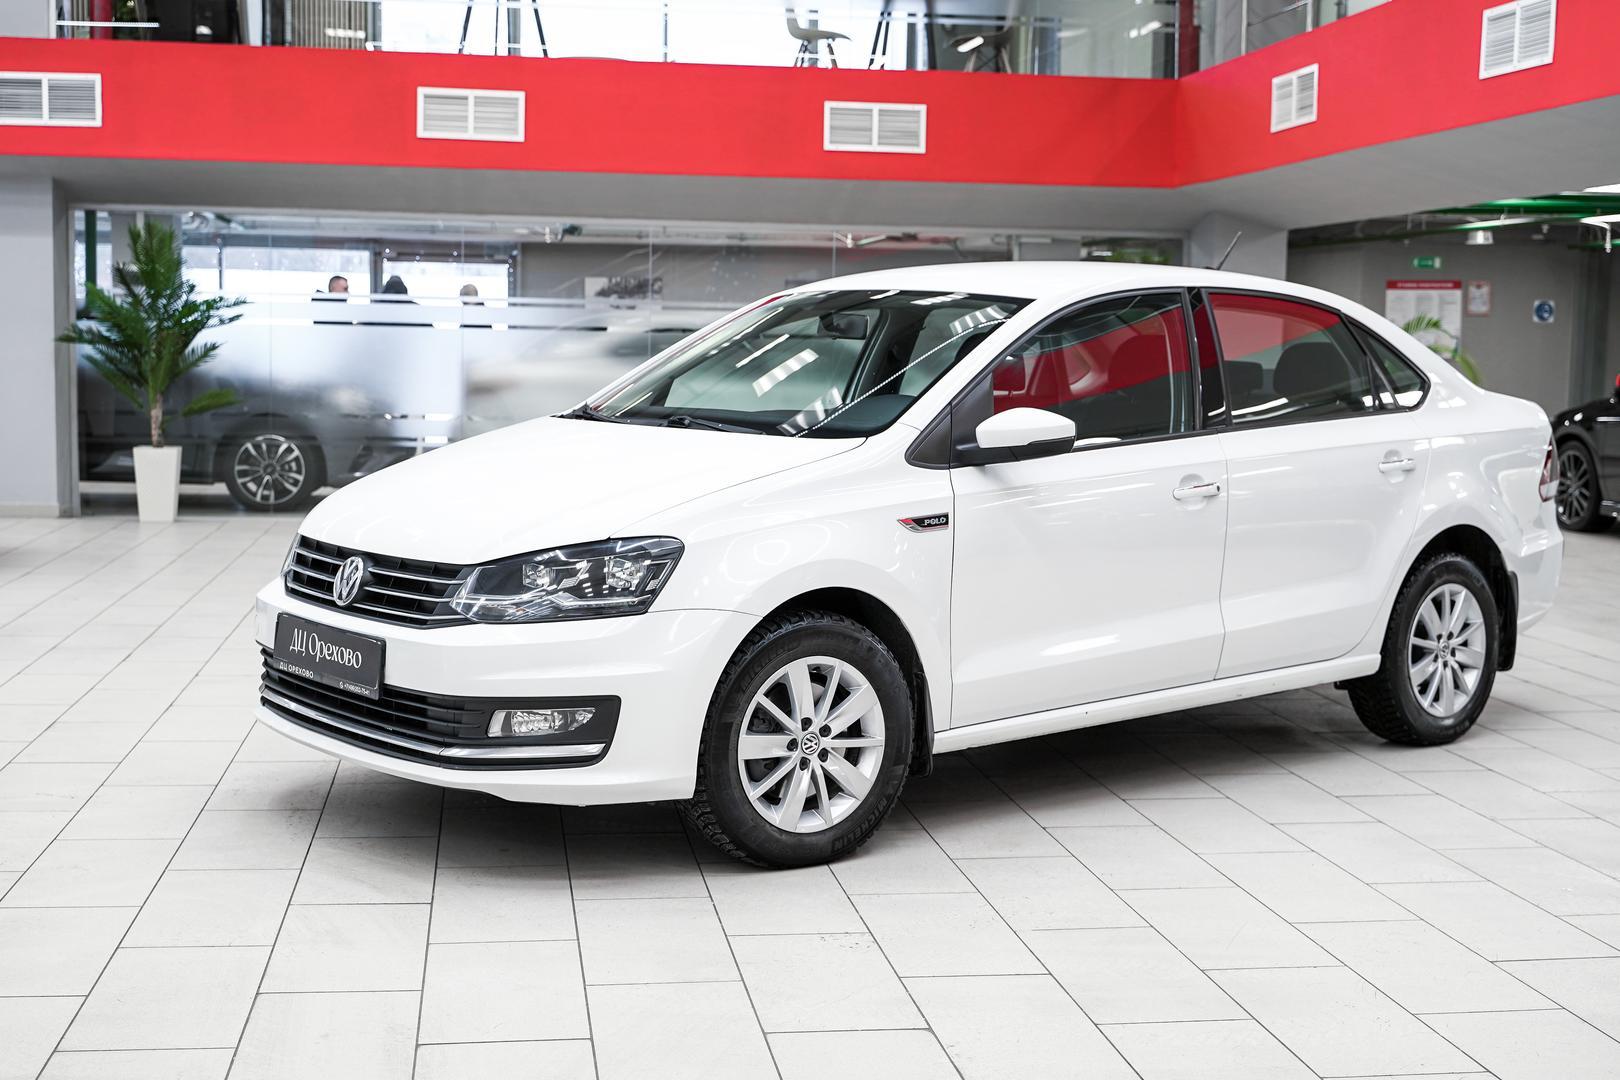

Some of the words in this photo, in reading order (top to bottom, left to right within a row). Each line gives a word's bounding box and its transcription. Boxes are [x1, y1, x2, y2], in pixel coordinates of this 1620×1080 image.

[924, 516, 946, 526] POLO
[289, 628, 307, 657] ДЦ
[308, 632, 362, 669] Орехово
[279, 661, 288, 672] ДЦ
[288, 664, 314, 679] ОРЕХОВО
[831, 797, 888, 851] MICHELIN
